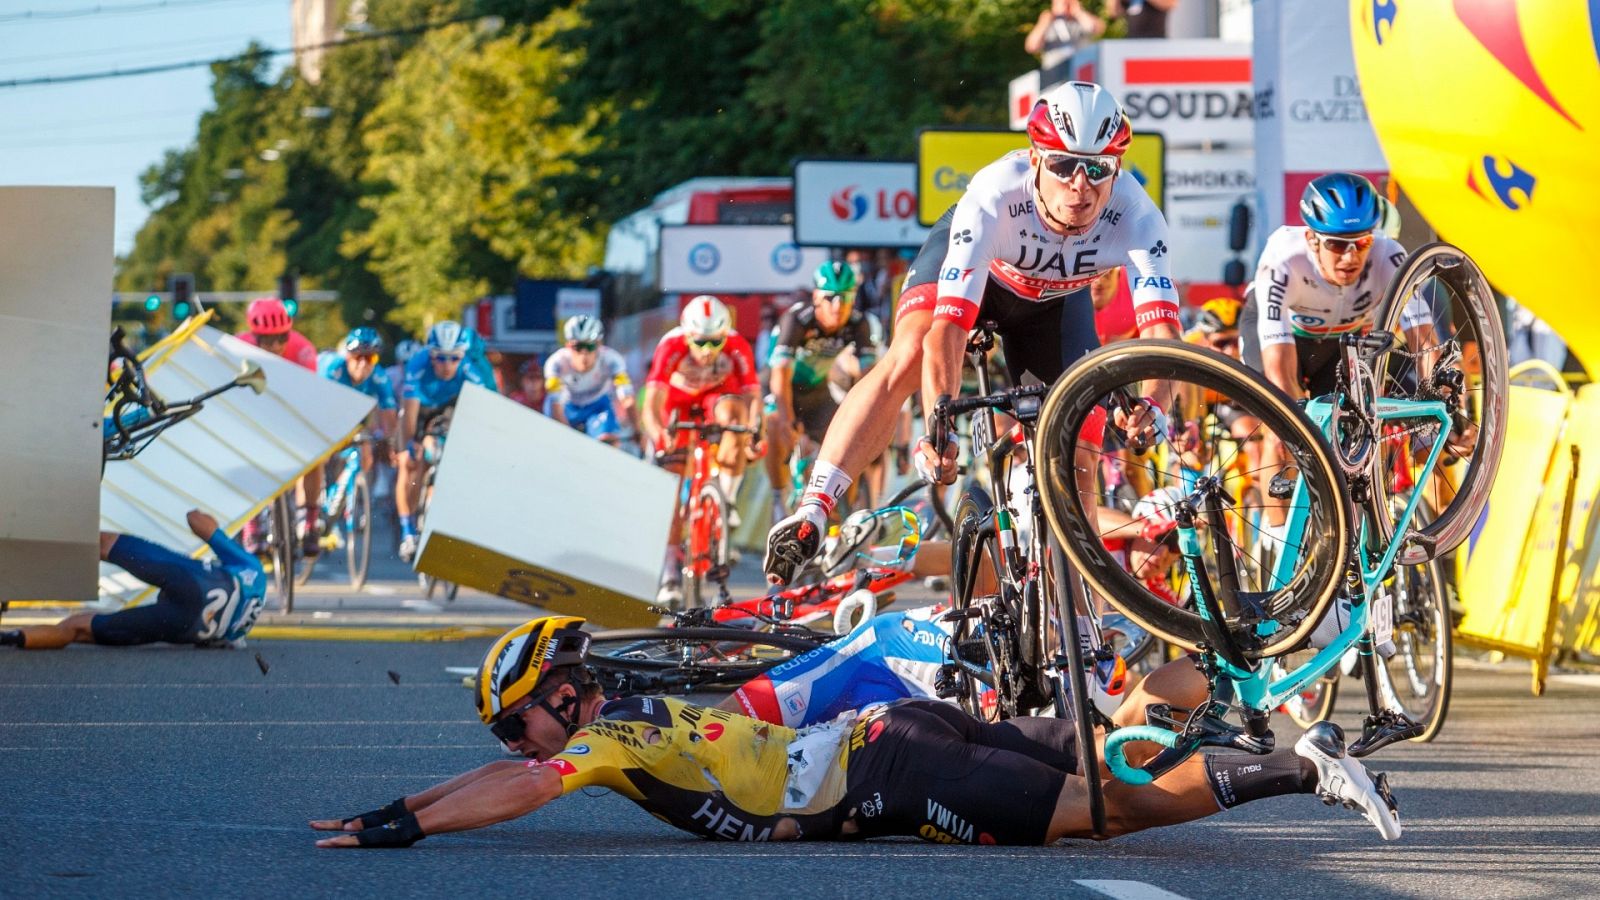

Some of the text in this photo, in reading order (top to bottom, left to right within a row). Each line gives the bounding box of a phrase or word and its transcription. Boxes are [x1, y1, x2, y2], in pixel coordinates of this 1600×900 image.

[1052, 103, 1067, 134] MET
[1123, 91, 1256, 120] SOUDA
[1106, 107, 1120, 139] MET
[1008, 200, 1033, 218] UAE
[1013, 244, 1098, 278] UAE
[1134, 276, 1172, 289] FAB
[1267, 269, 1288, 321] BMC
[1186, 557, 1212, 621] Bianchi
[531, 636, 549, 669] JUMBO
[544, 638, 559, 659] VISMA
[926, 798, 974, 843] VISMA
